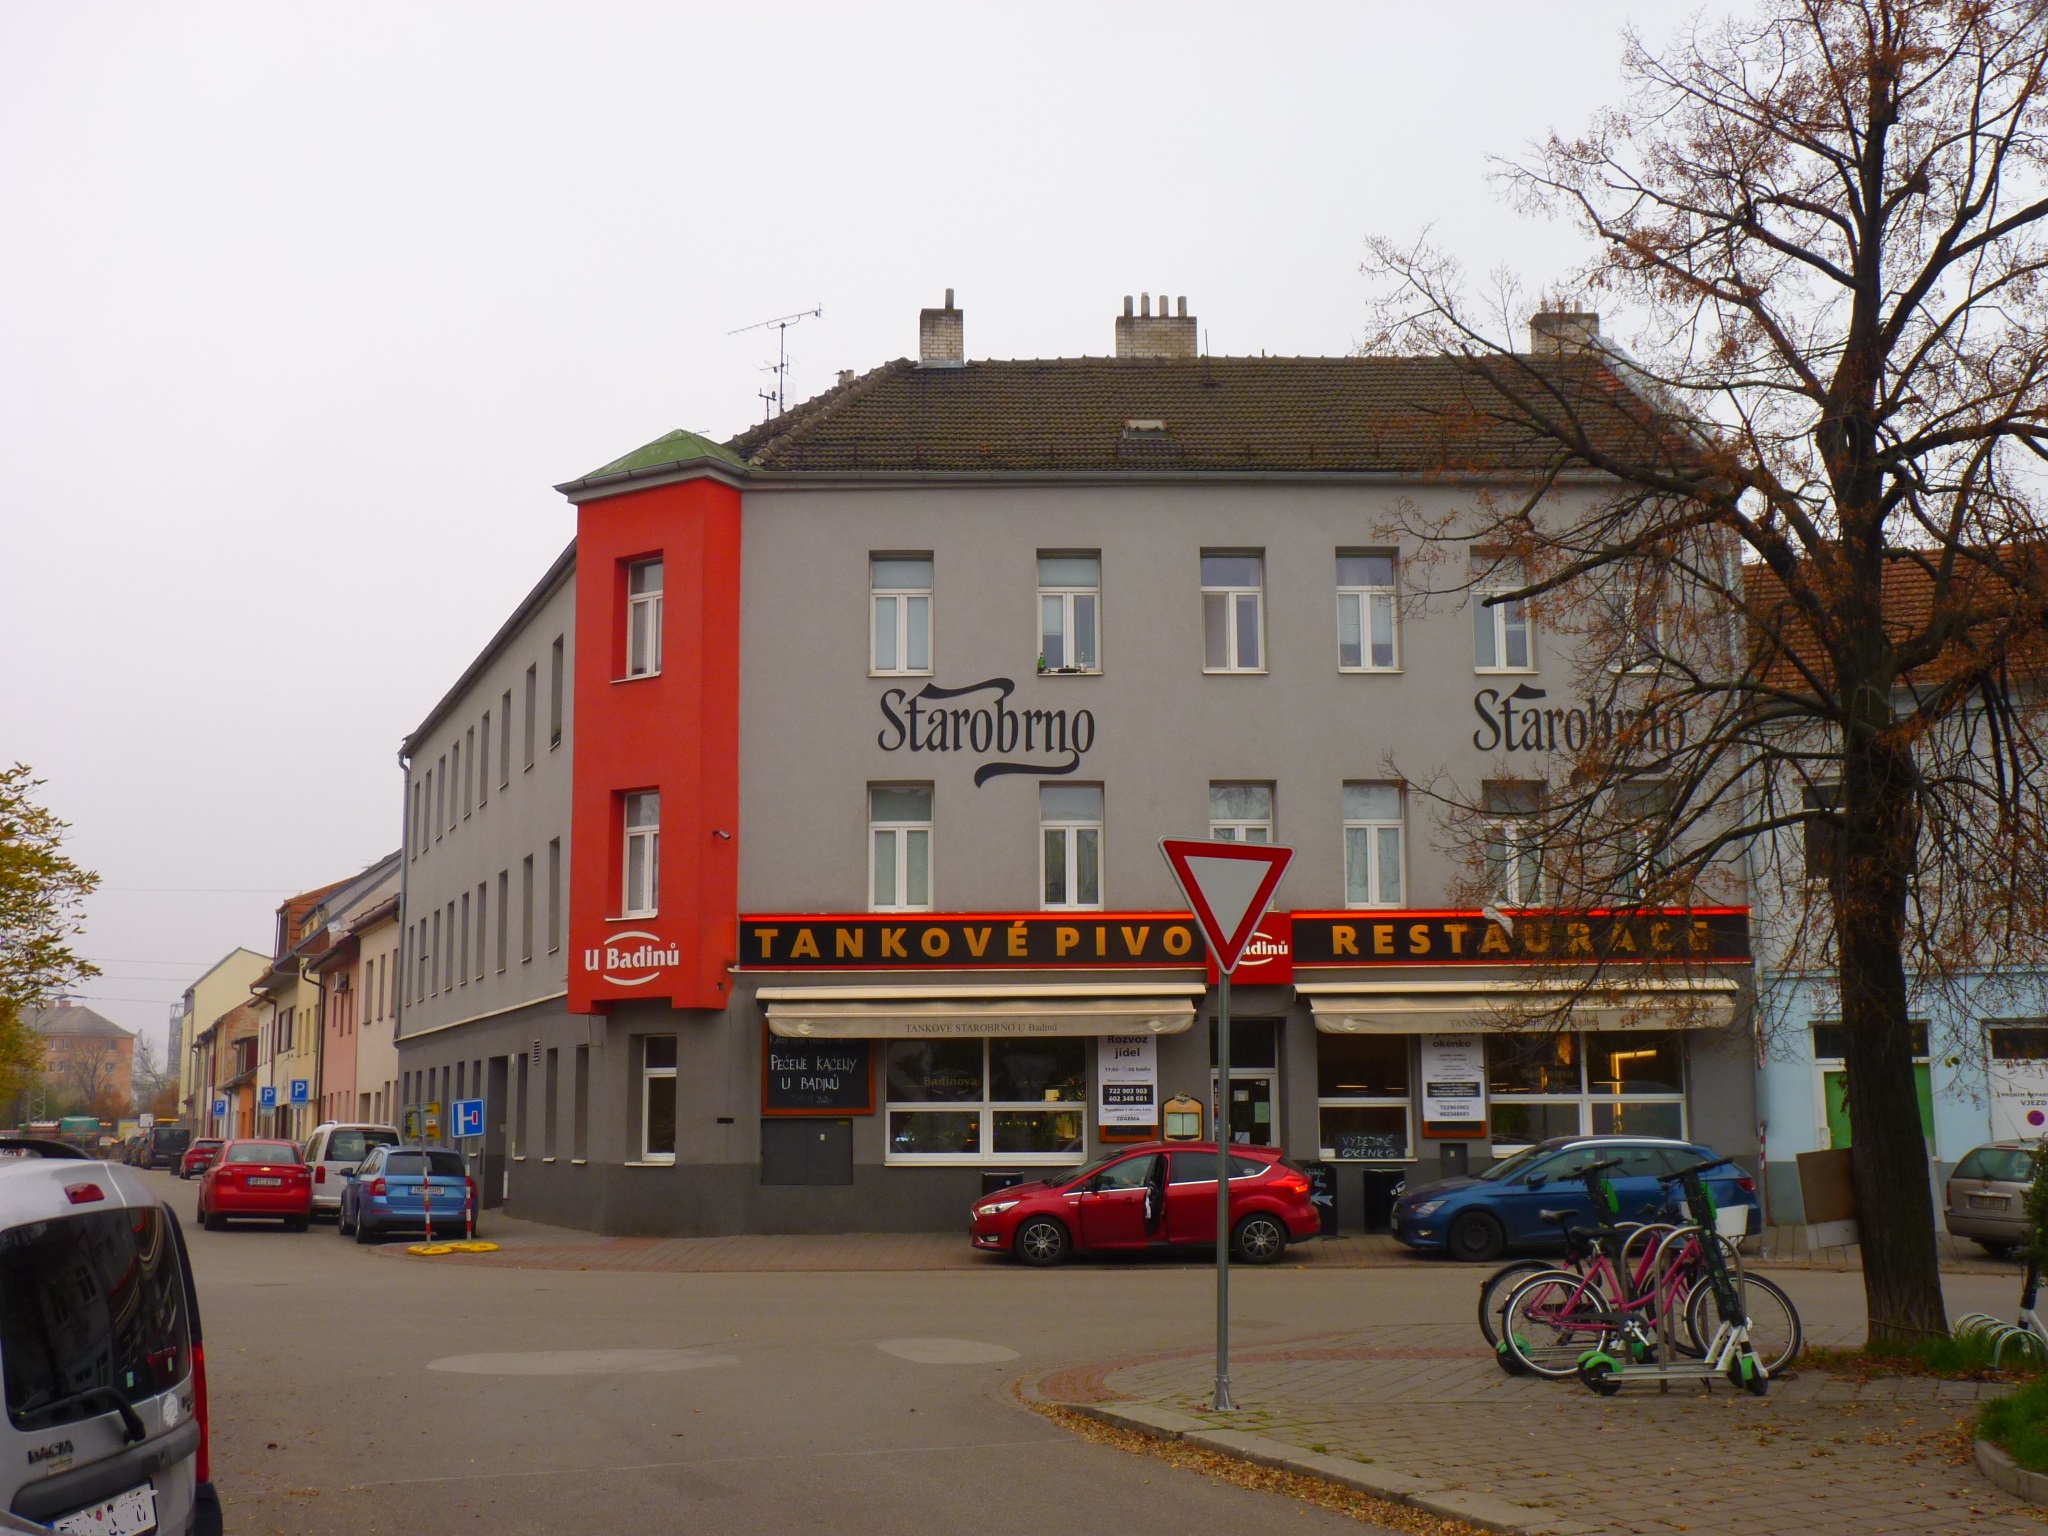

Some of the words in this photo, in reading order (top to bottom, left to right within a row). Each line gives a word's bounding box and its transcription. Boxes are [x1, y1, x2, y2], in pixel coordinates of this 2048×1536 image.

[878, 678, 1095, 788] Starobrno
[754, 921, 1029, 958] TANKOVÉ
[1057, 926, 1193, 956] PIVO
[1332, 922, 1710, 955] RESTAURACE
[606, 942, 680, 970] Badinů
[905, 1024, 952, 1033] TANKOVÉ
[955, 1023, 1015, 1032] STAROBRNO
[1018, 1023, 1026, 1031] U
[1028, 1023, 1057, 1032] Badinů
[1107, 1035, 1148, 1044] Rozvoz
[1114, 1047, 1140, 1059] jídel
[781, 1077, 791, 1090] U
[924, 1076, 977, 1086] Badinova
